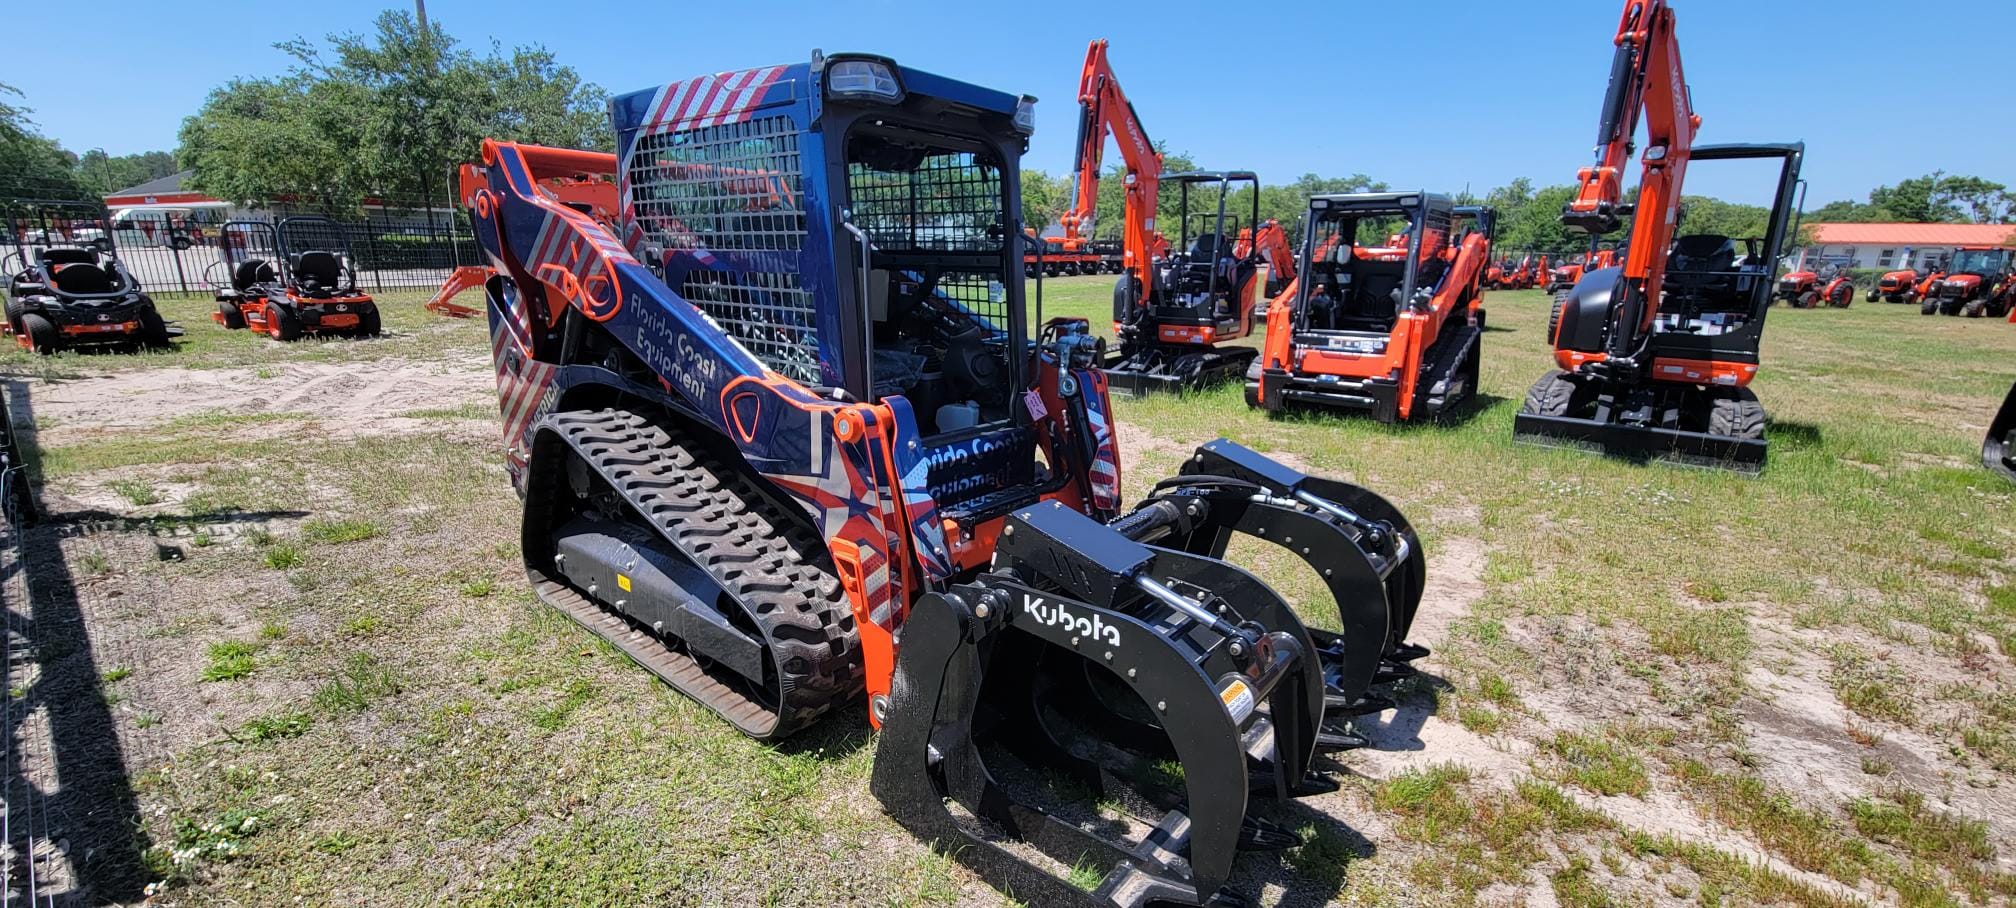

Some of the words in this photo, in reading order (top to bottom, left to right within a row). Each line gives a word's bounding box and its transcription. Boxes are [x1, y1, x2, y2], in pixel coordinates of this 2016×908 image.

[631, 293, 673, 346] Florida
[678, 333, 716, 379] Coast
[637, 326, 706, 400] Equipment
[1024, 594, 1120, 646] Kubota
